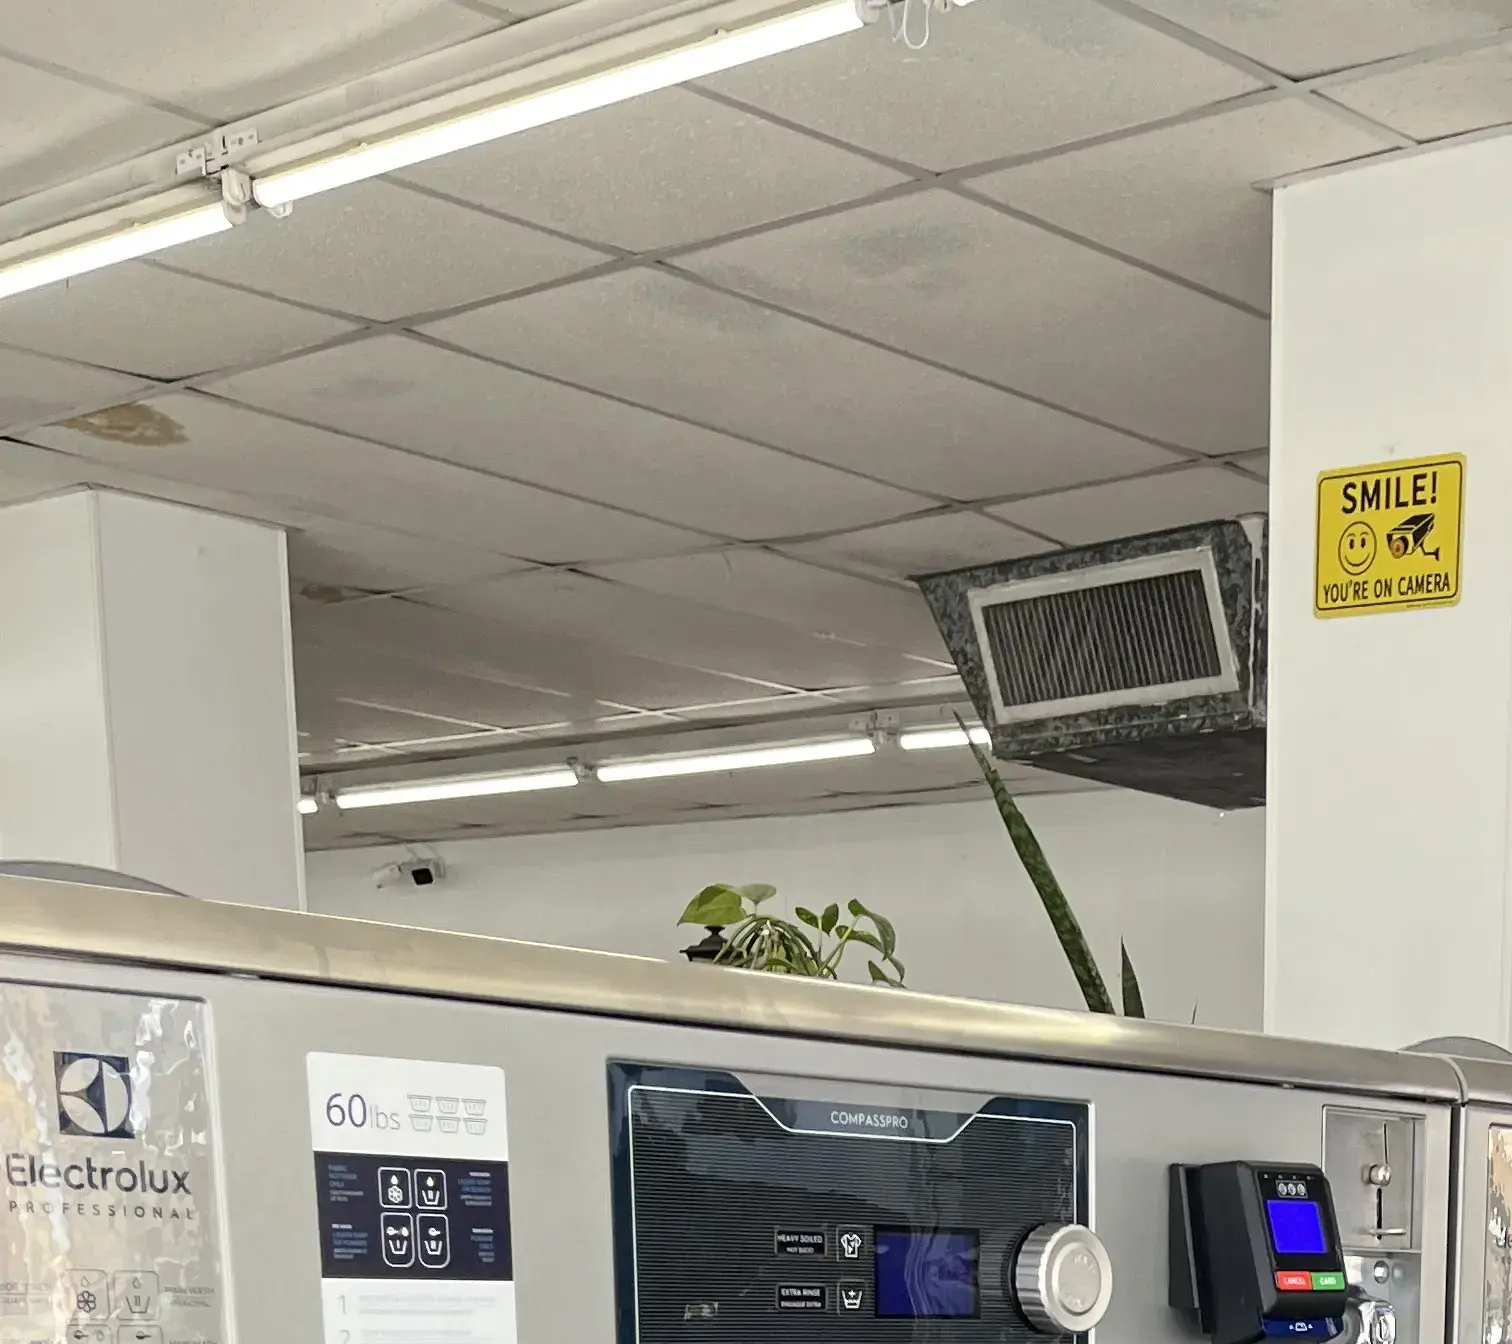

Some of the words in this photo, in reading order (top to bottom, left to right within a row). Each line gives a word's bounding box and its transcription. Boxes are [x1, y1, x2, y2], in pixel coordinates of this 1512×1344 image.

[1341, 471, 1437, 514] SMILE!
[1323, 580, 1369, 603] YOU'RE
[1374, 578, 1393, 598] ON
[1398, 572, 1451, 596] CAMERA
[830, 1110, 909, 1129] COMPASSPRO
[5, 1152, 192, 1195] Electrolux
[8, 1200, 195, 1220] PROFESSIONAL
[1319, 1276, 1337, 1286] CARD
